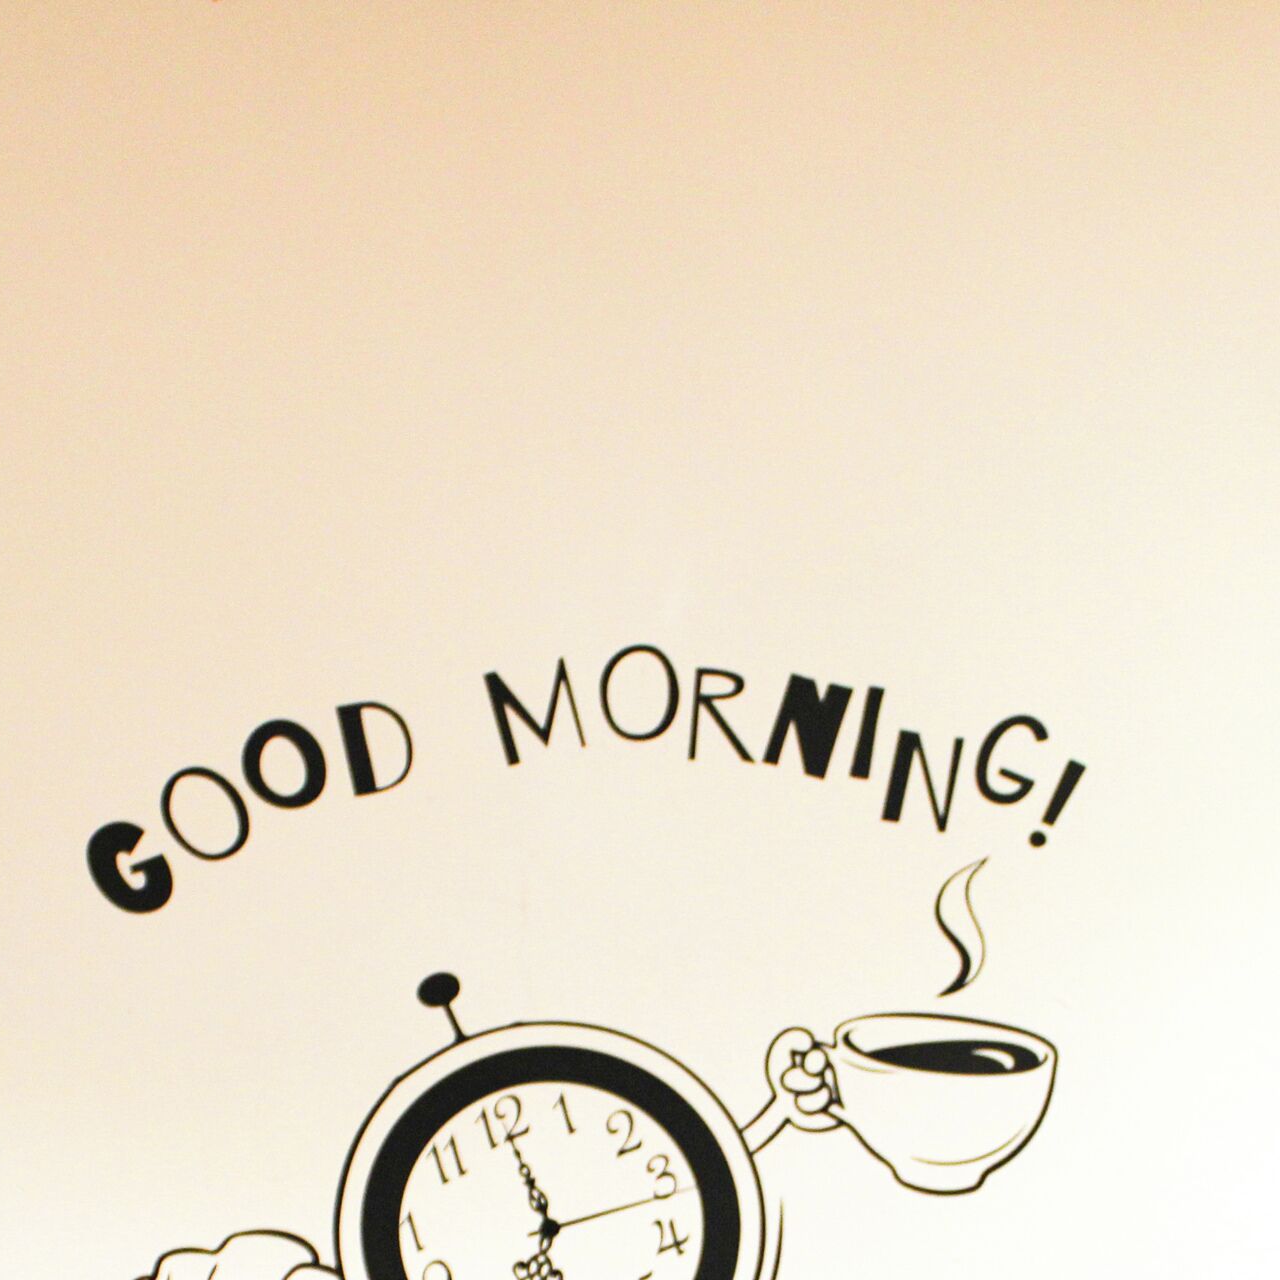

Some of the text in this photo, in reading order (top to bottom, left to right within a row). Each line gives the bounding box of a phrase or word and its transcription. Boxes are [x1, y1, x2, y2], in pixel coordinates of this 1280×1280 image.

[85, 643, 1087, 915] GOOD MORNING!
[475, 1093, 530, 1150] 12
[552, 1091, 577, 1135] 1
[606, 1109, 643, 1158] 2
[426, 1135, 468, 1185] 11
[646, 1154, 679, 1201] 3
[653, 1217, 690, 1256] 4
